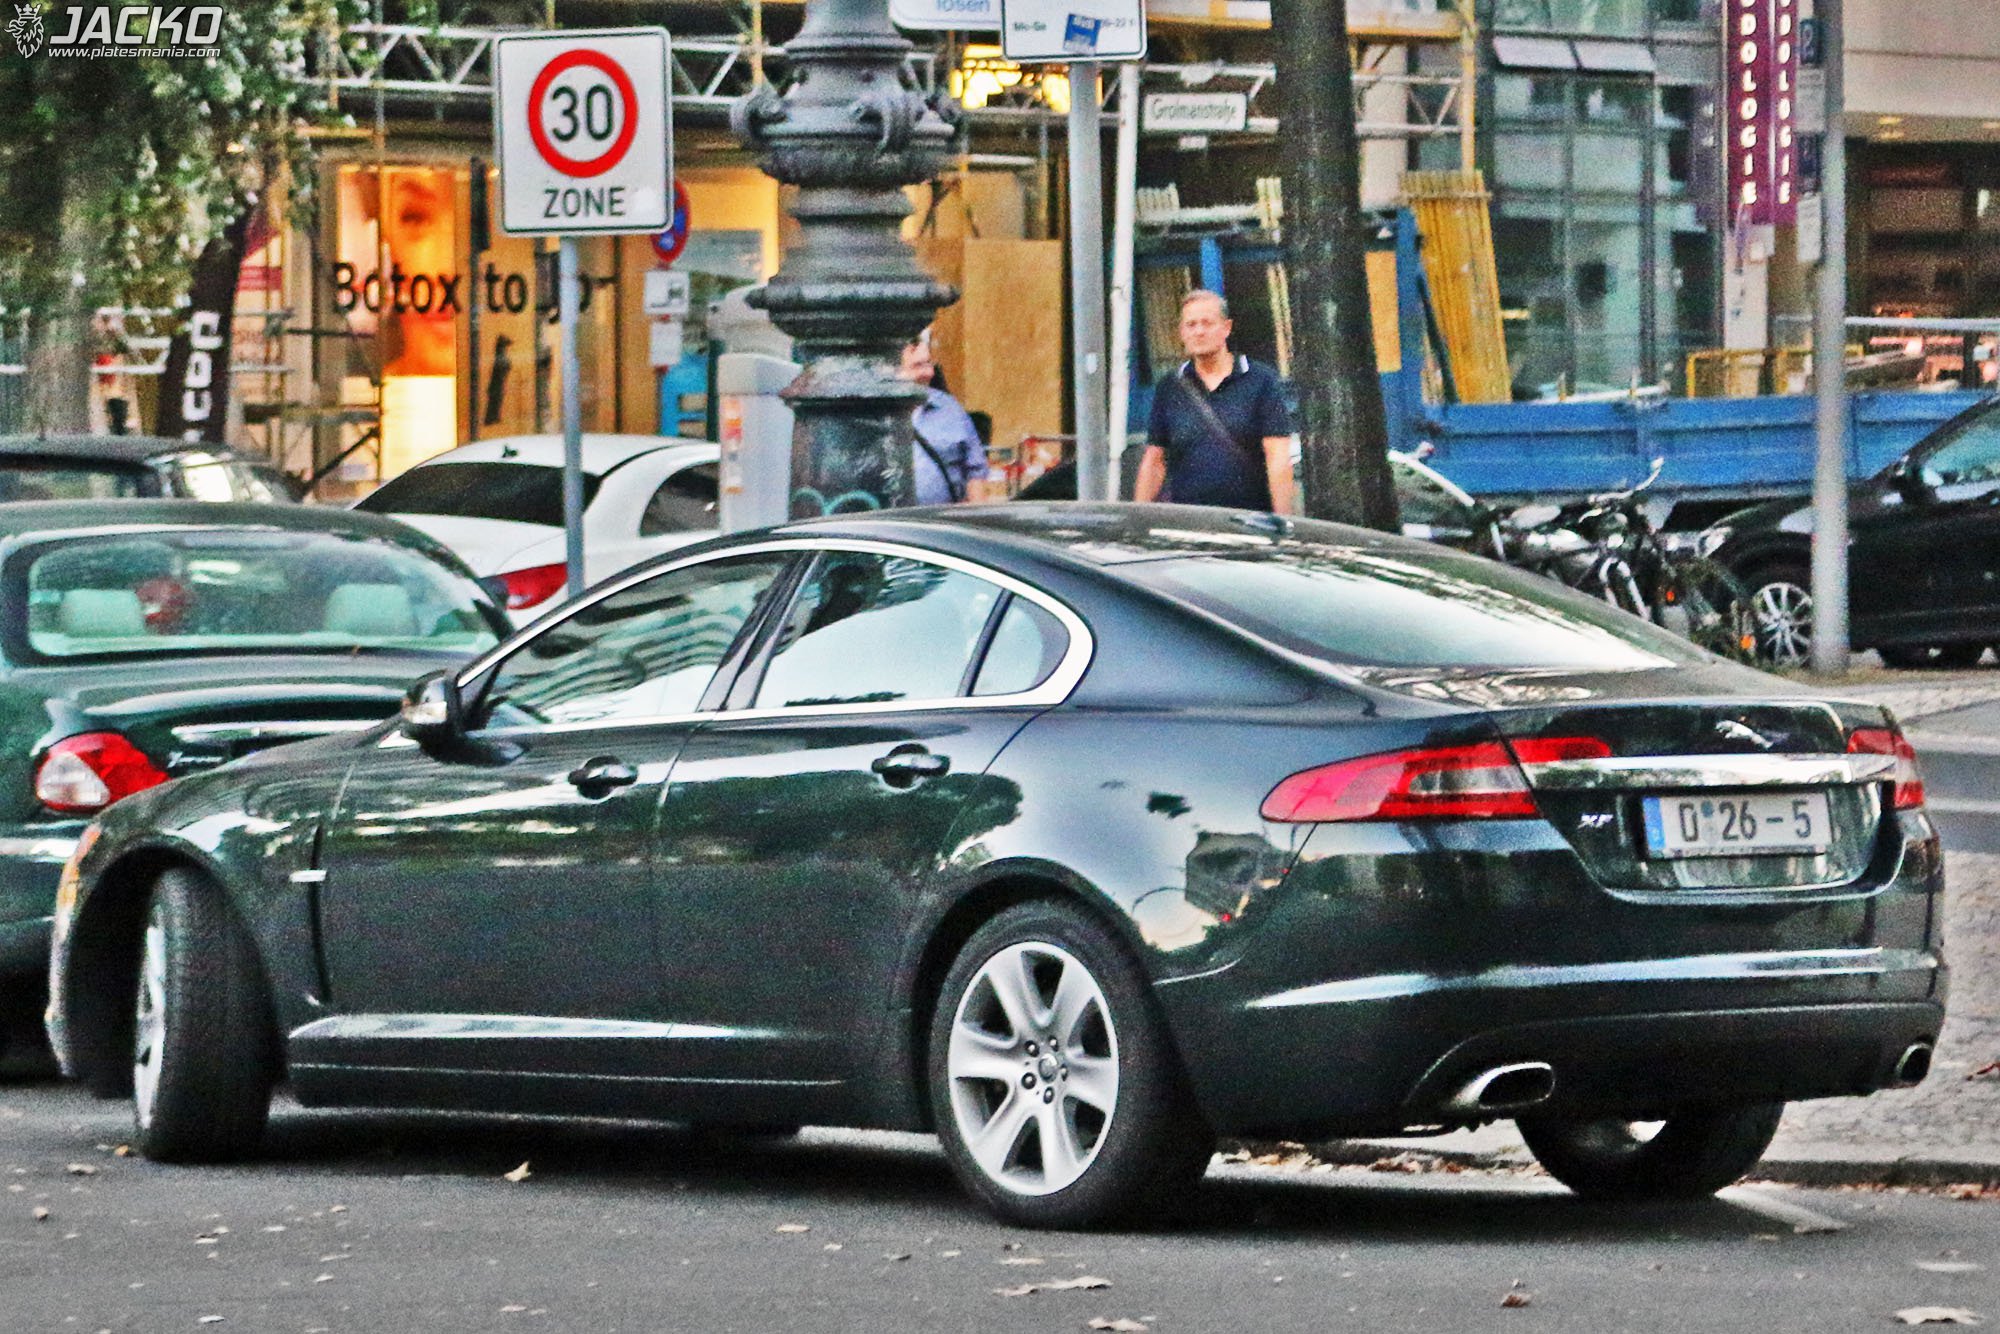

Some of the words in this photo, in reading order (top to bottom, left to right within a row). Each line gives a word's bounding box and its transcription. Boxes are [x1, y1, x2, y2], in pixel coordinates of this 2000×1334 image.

[551, 84, 613, 142] 30
[543, 186, 627, 218] ZONE
[334, 262, 462, 314] Botox
[485, 262, 527, 313] to
